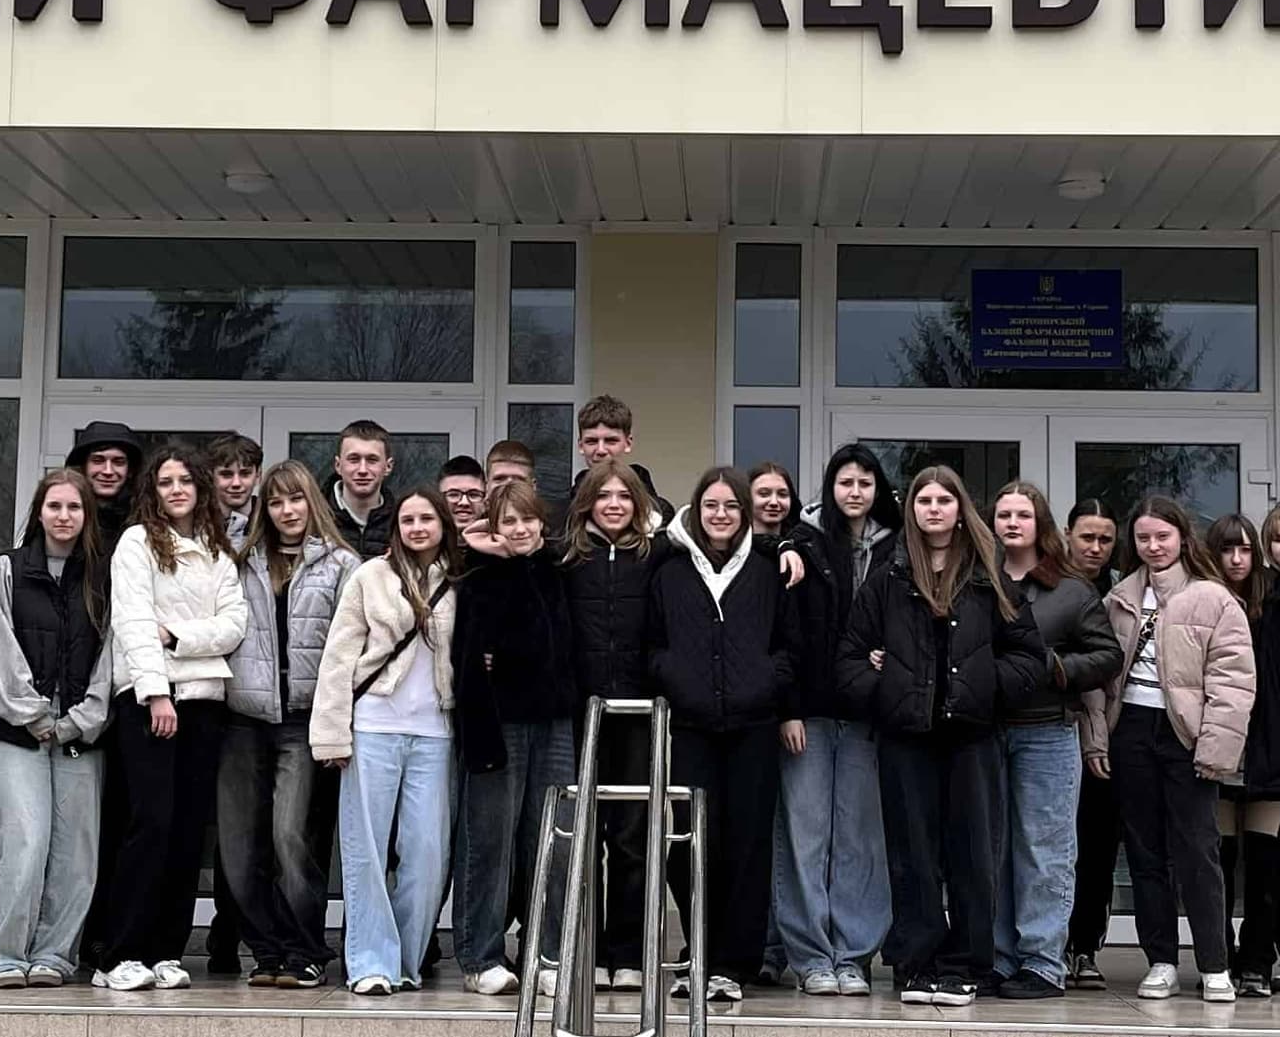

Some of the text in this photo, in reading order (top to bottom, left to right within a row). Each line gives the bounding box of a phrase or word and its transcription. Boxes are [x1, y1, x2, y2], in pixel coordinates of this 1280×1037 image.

[1008, 317, 1086, 326] ЖИТОМИРСЬКИЙ
[1024, 327, 1114, 336] ФАРМАЦЕВТИЧНИЙ
[1051, 339, 1091, 347] КОЛЕДЖ
